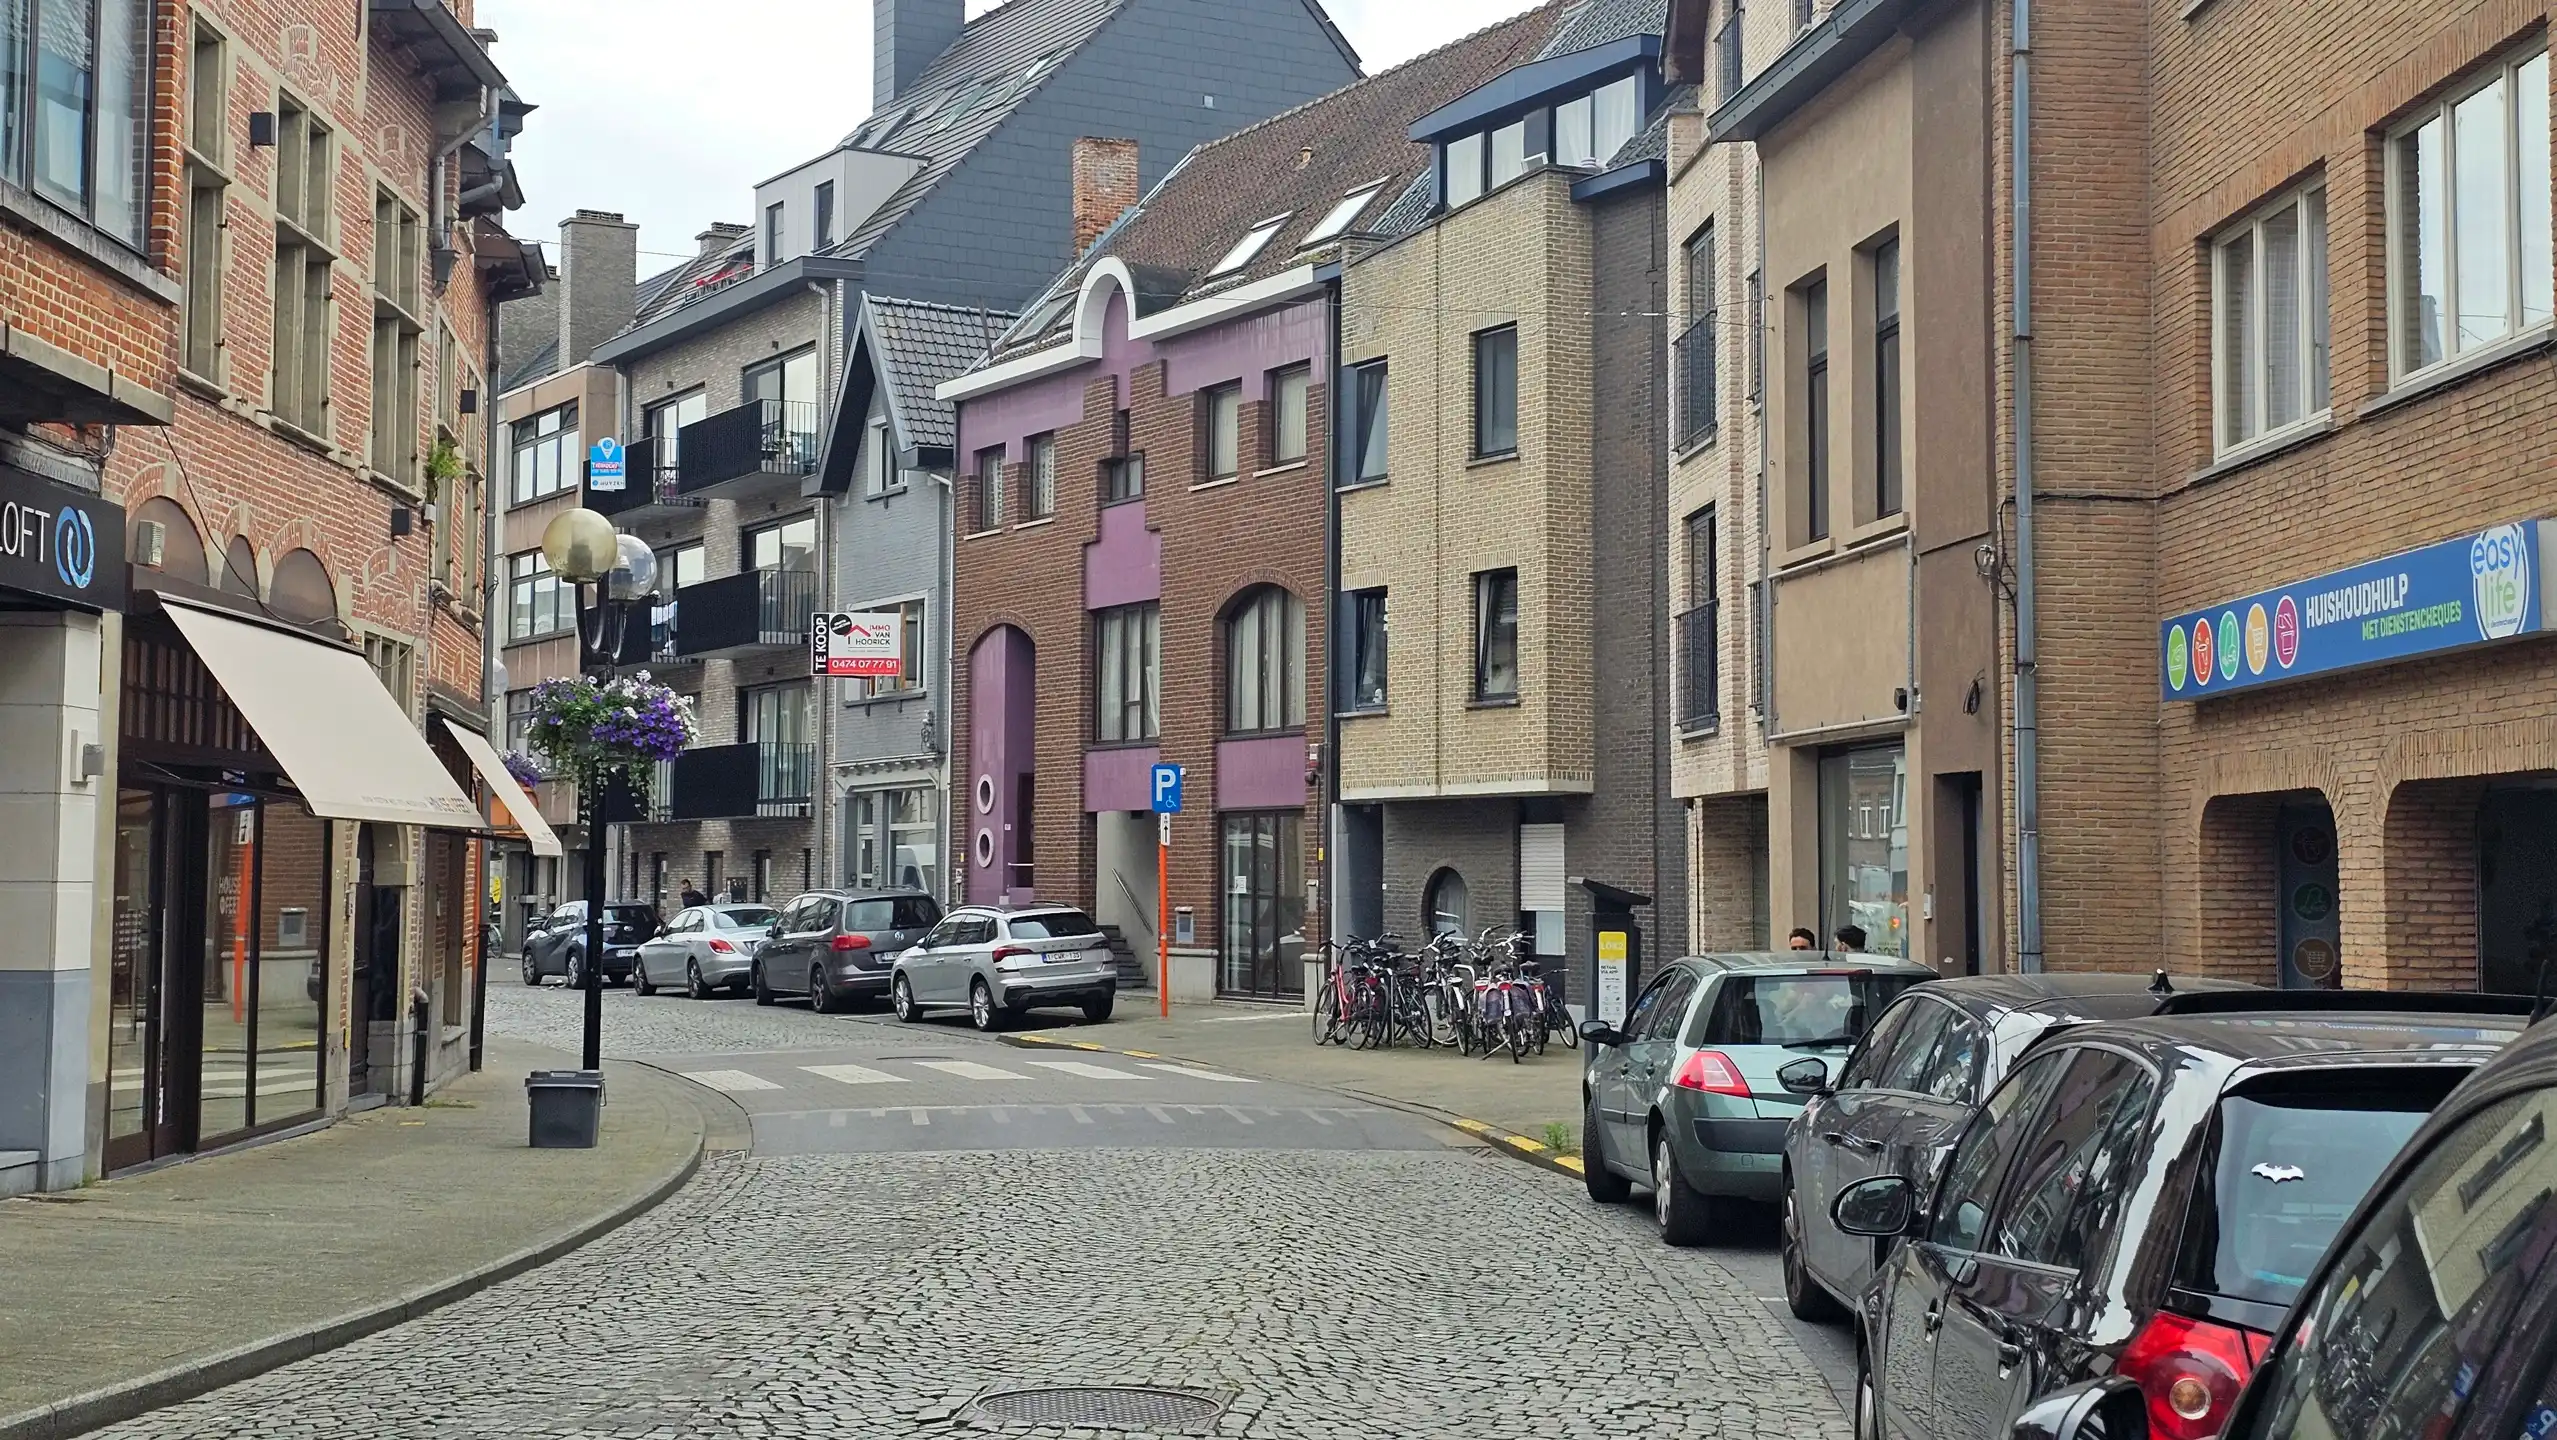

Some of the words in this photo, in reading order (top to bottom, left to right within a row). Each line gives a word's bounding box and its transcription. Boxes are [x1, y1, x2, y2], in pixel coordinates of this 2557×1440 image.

[0, 501, 51, 562] OFT
[2473, 528, 2522, 580] easy
[2305, 573, 2409, 629] HUISHOUDHULP
[2484, 570, 2516, 622] life
[815, 617, 827, 652] KOOP
[2361, 619, 2379, 641] MET
[2380, 600, 2462, 638] DIENSTENCHEQUES
[815, 655, 827, 671] TE
[831, 660, 857, 668] 0474
[858, 660, 872, 668] 07
[872, 660, 885, 668] 77
[885, 660, 897, 668] 91
[1155, 768, 1177, 801] P
